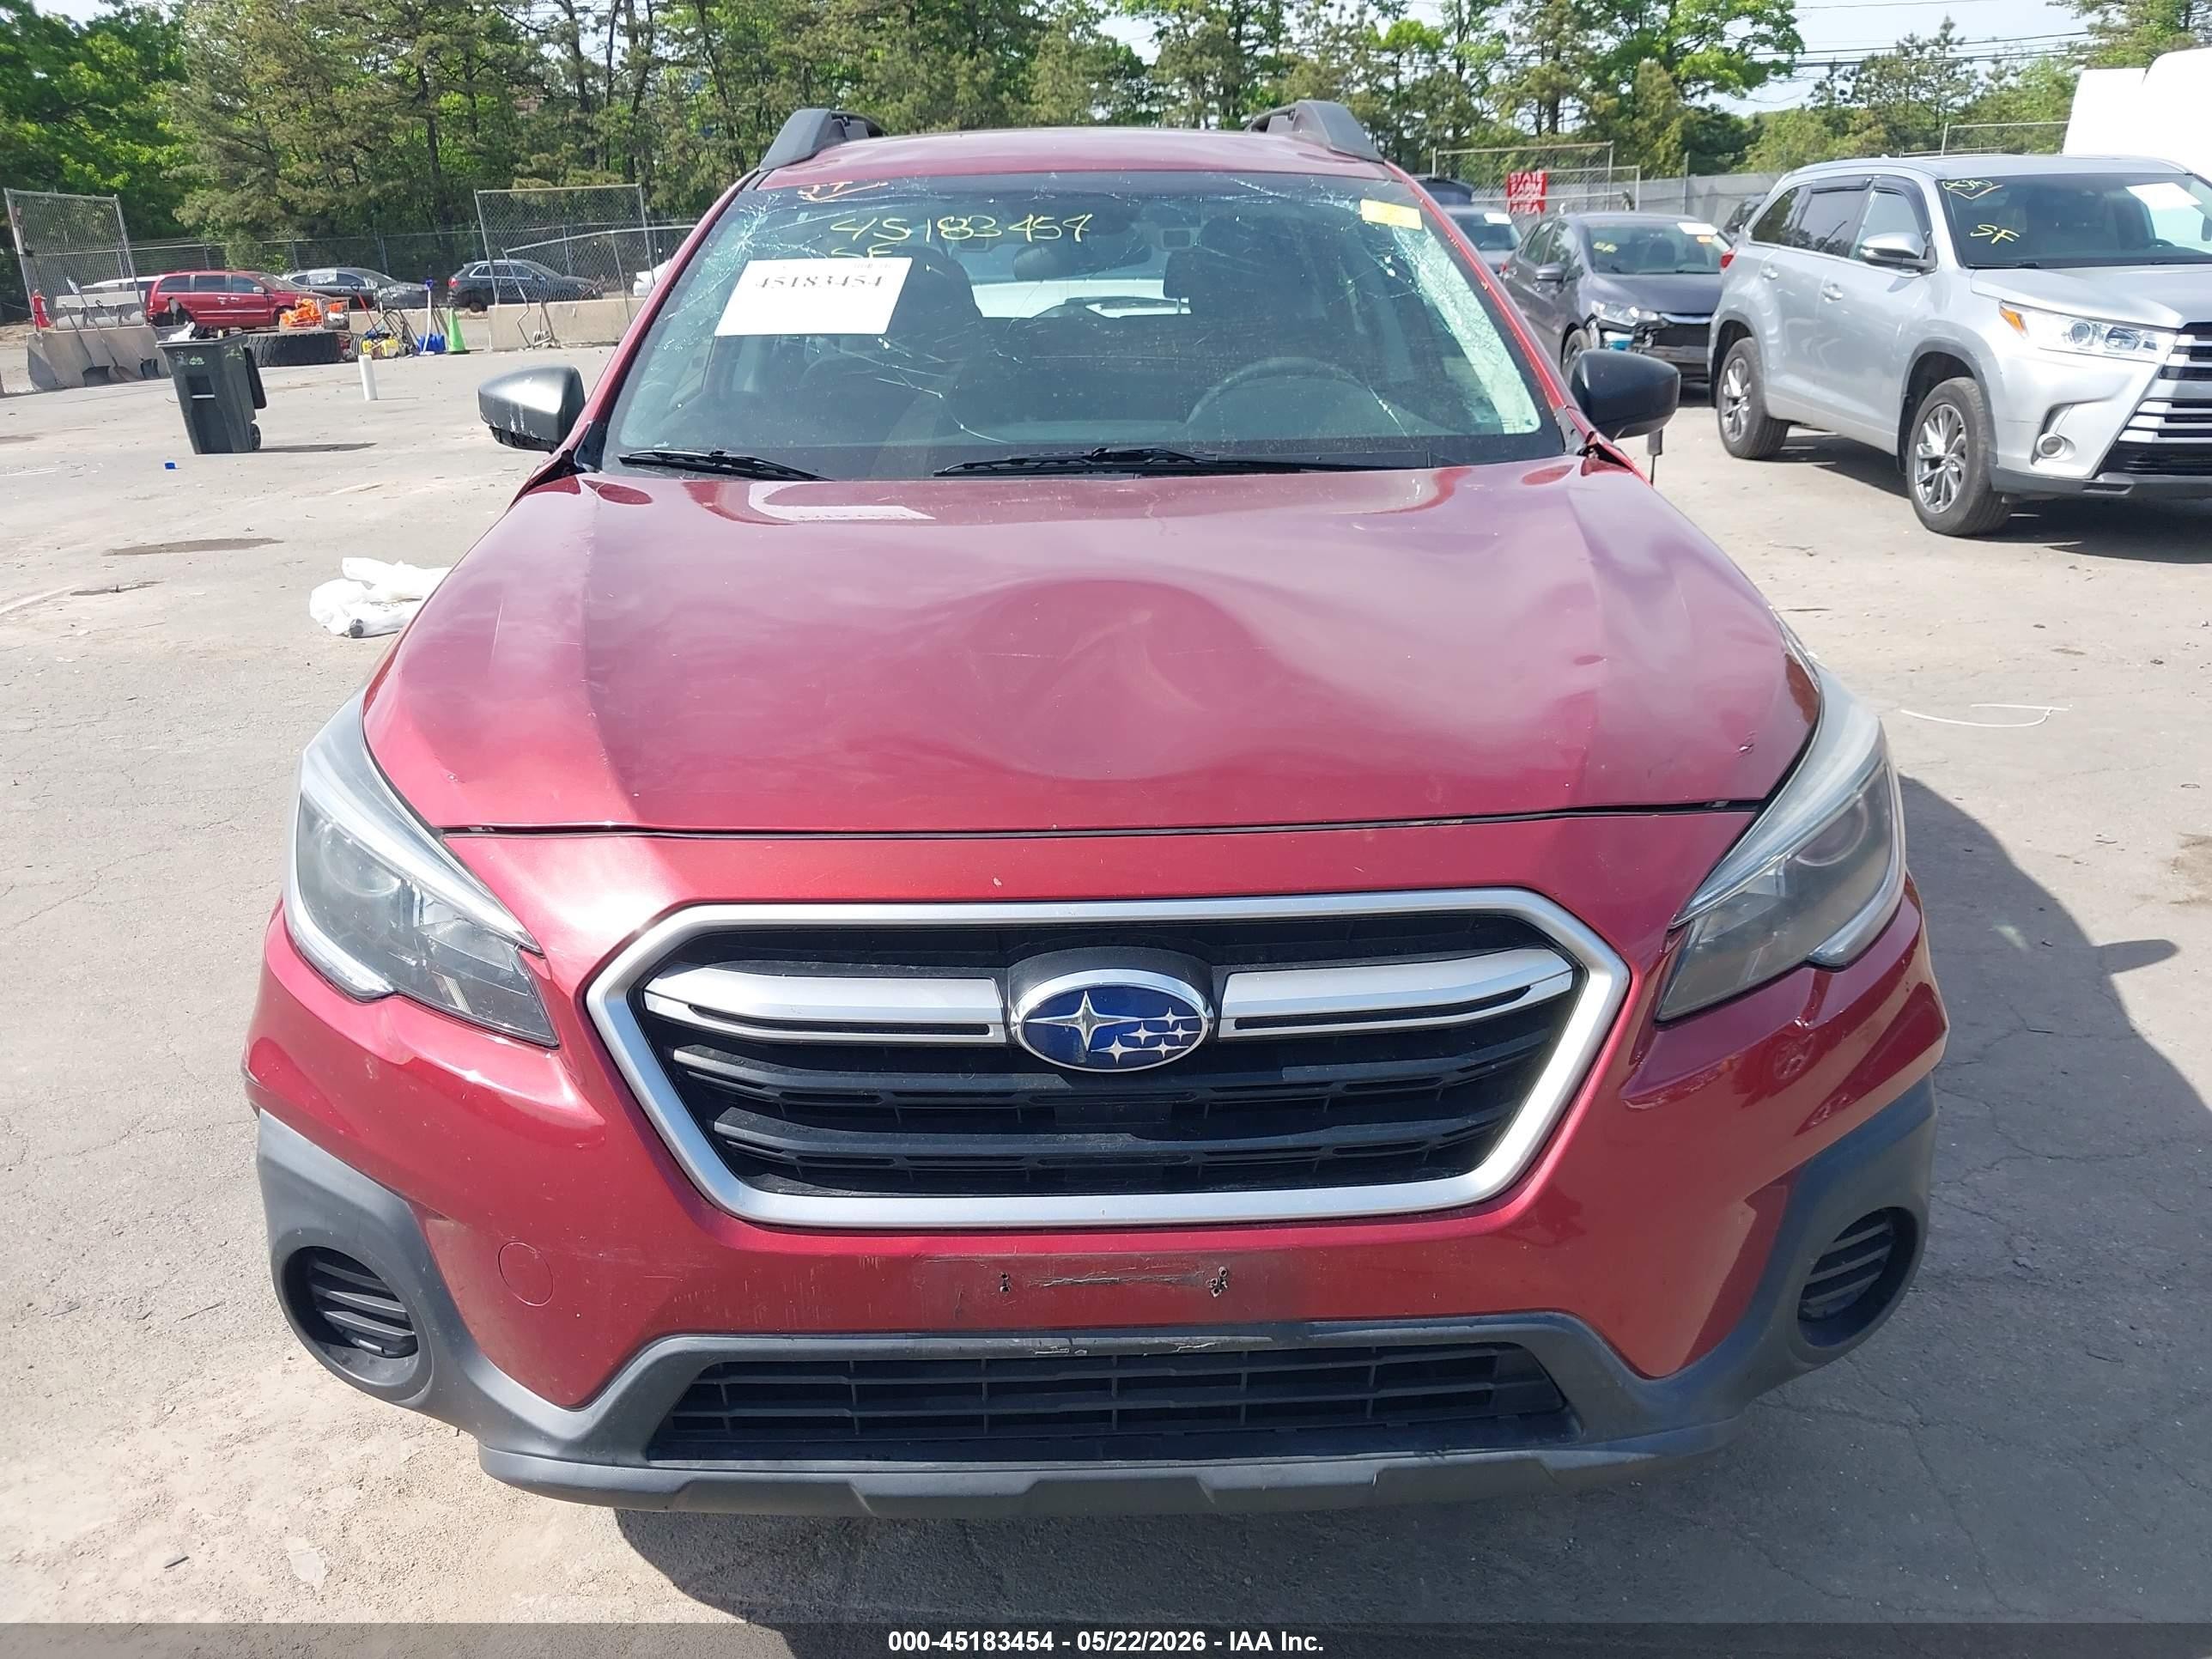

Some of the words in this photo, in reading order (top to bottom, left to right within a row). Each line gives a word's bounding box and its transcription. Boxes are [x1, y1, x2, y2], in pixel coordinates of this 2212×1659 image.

[1510, 171, 1544, 183] STATE
[1510, 182, 1542, 194] FARM
[1510, 203, 1540, 215] AREA
[1970, 224, 2021, 244] SF
